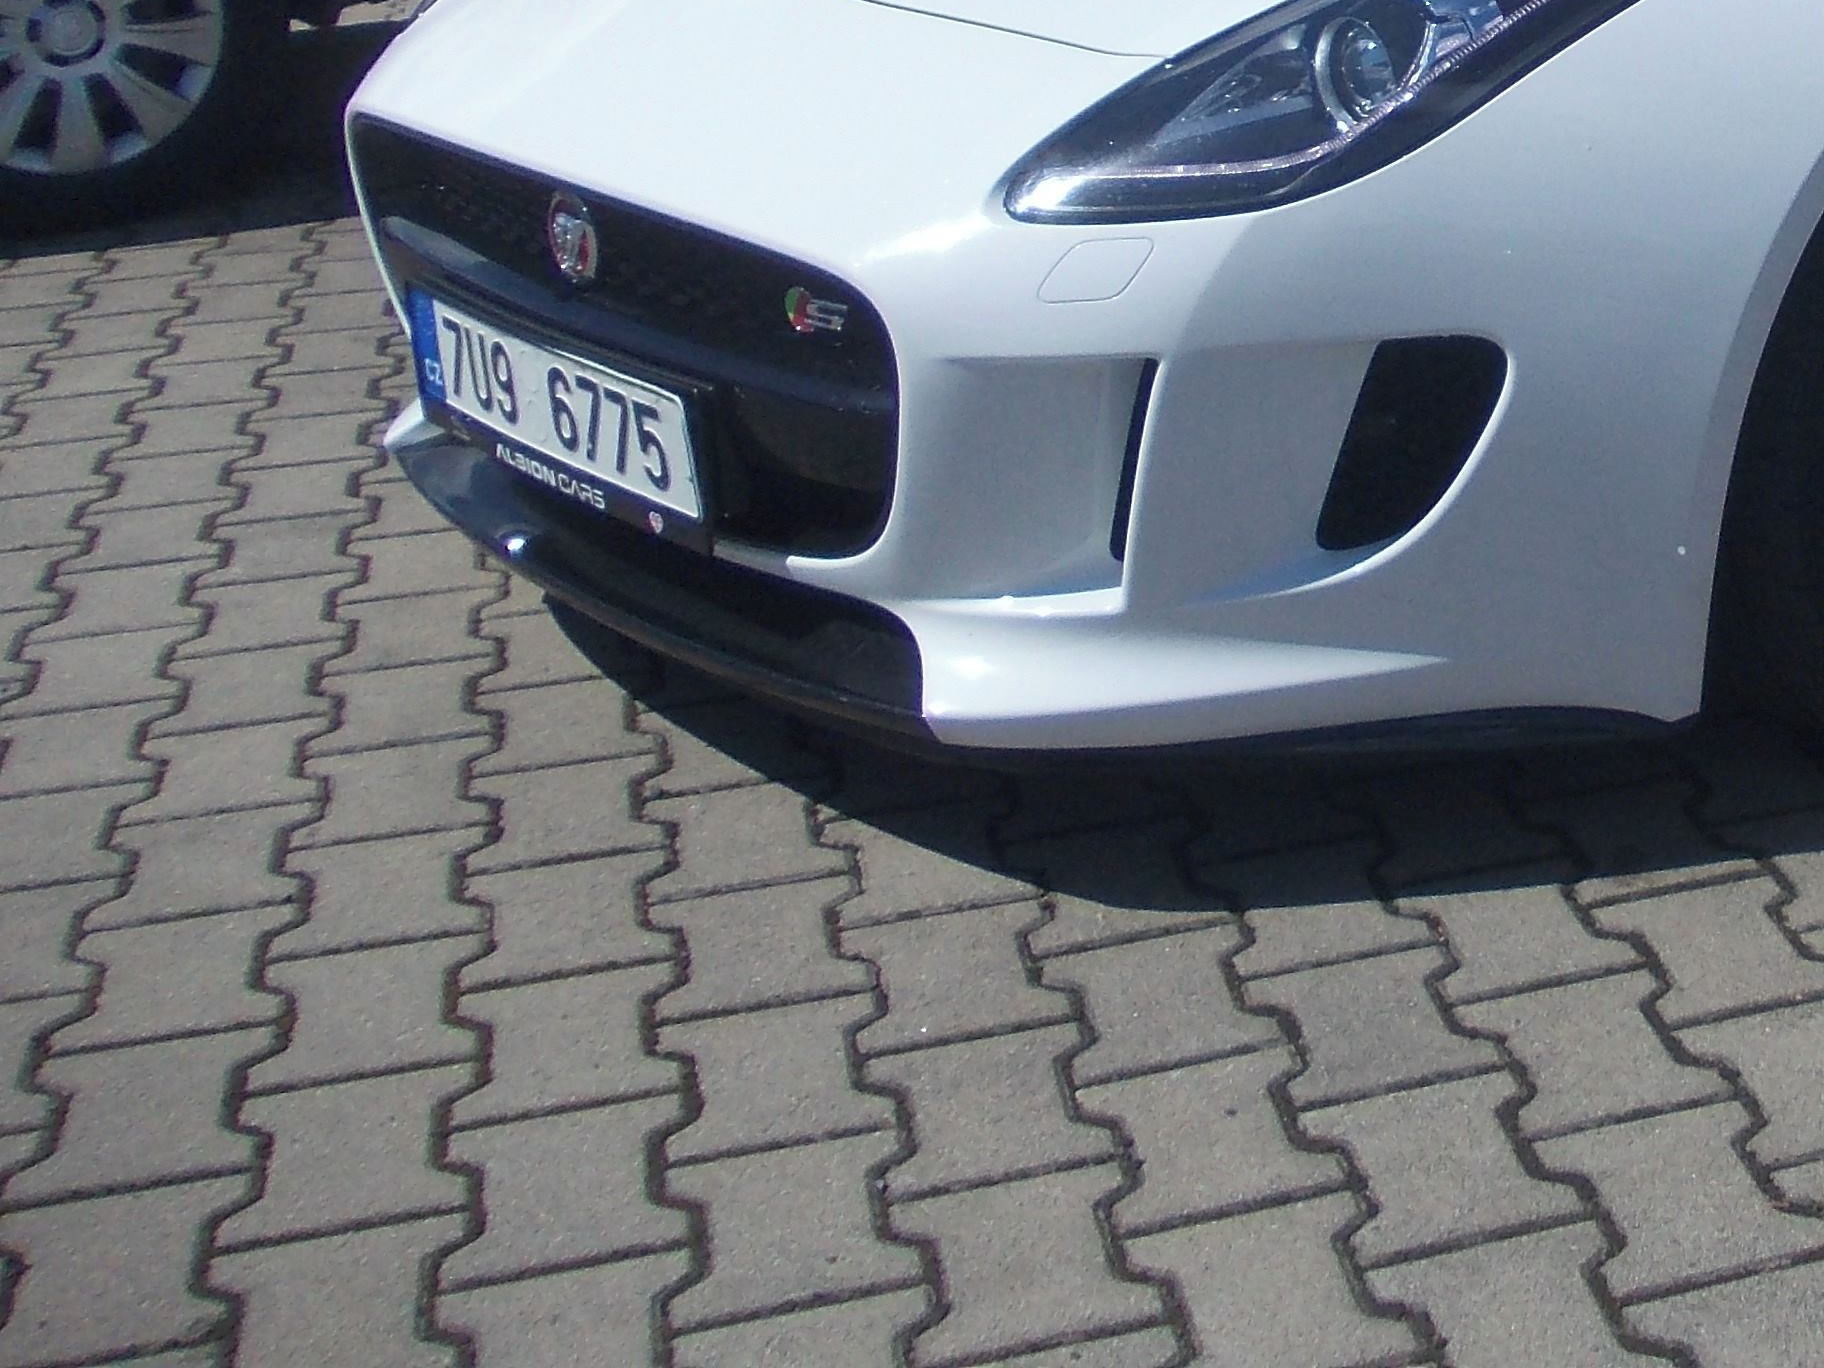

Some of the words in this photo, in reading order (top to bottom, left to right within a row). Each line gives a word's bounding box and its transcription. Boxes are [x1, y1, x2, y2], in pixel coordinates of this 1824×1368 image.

[424, 357, 444, 386] CZ
[442, 314, 518, 425] 7U9
[547, 365, 672, 492] 6775
[496, 443, 557, 488] ALBION
[557, 473, 605, 509] CARS
